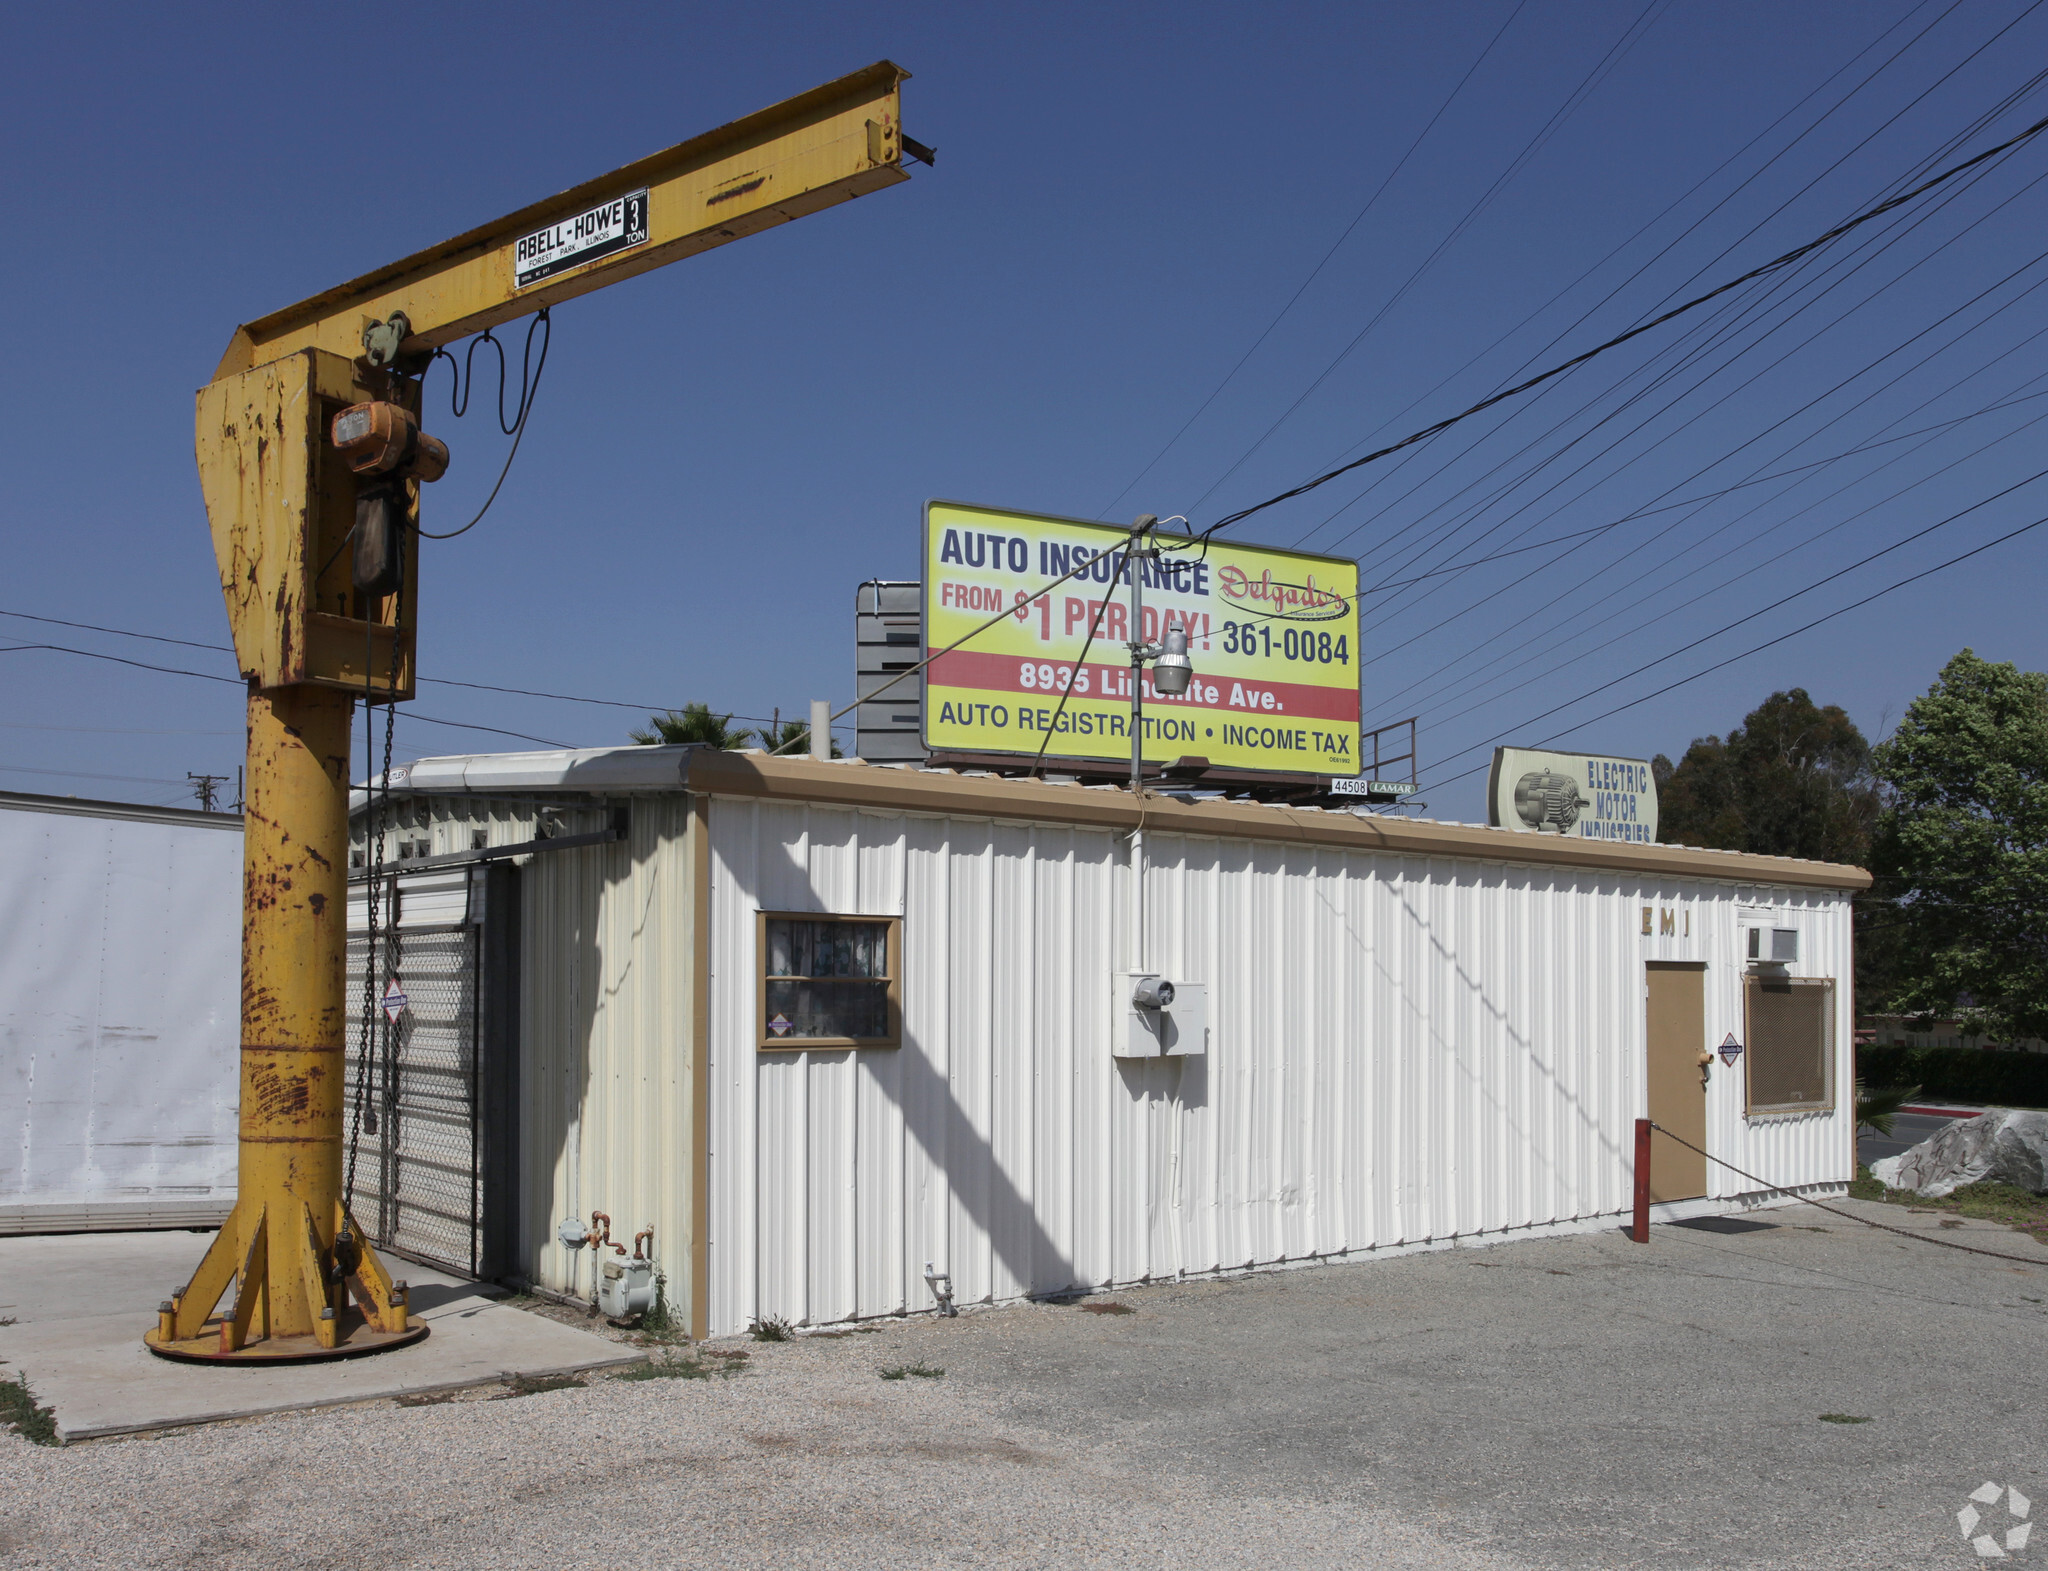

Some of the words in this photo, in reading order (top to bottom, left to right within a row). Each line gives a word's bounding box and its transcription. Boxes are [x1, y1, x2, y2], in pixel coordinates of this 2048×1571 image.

[518, 202, 622, 262] ABELL-HOWE
[626, 229, 645, 244] TON
[631, 200, 639, 232] 3
[528, 252, 552, 268] FOREST
[586, 231, 610, 246] ILLINOIS
[940, 528, 1028, 573] AUTO
[1217, 564, 1345, 613] Delgado's
[942, 582, 1003, 613] FROM
[1014, 589, 1050, 641] $1
[1065, 596, 1128, 642] PER
[1223, 620, 1349, 666] 361-0084
[1019, 662, 1091, 693] 8935
[1101, 669, 1220, 704] Limte
[1228, 682, 1284, 710] Ave.
[939, 701, 1009, 728] AUTO
[1018, 707, 1195, 742] REGISTRTION
[1223, 723, 1307, 751] INCOME
[1312, 731, 1350, 754] TAX
[1334, 780, 1366, 793] 44508
[1373, 782, 1412, 794] LAMAR
[1587, 760, 1647, 794] ELECTRIC
[1596, 791, 1637, 822] MOTOR
